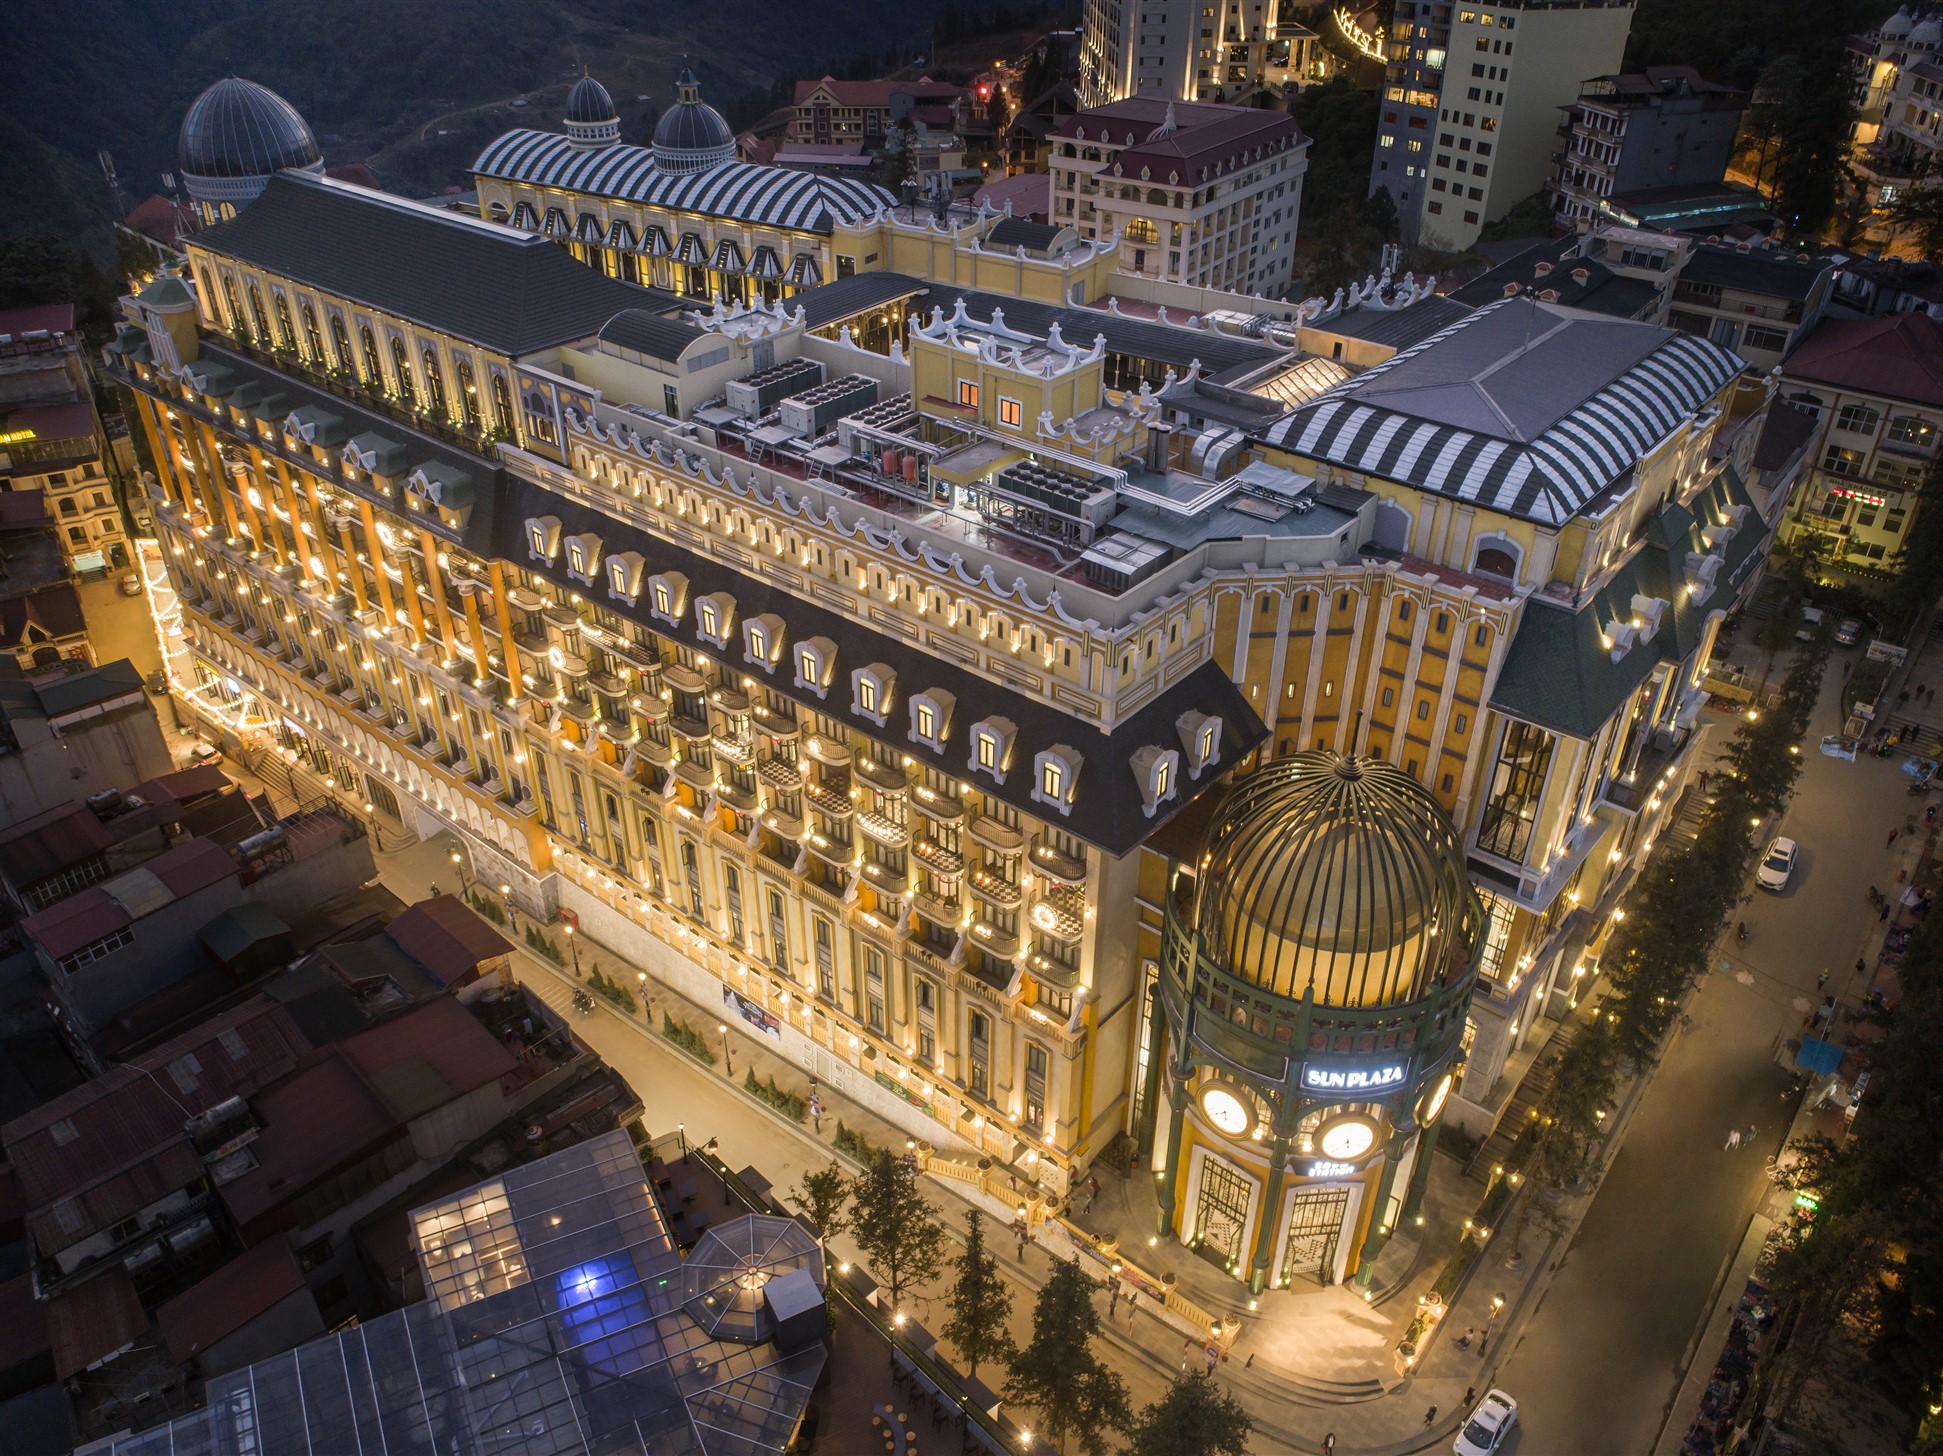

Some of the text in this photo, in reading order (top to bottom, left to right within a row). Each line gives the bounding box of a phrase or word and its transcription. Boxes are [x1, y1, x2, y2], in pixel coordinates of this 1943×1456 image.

[10, 429, 36, 440] HOTEL
[1308, 1066, 1402, 1088] SUN PLAZA
